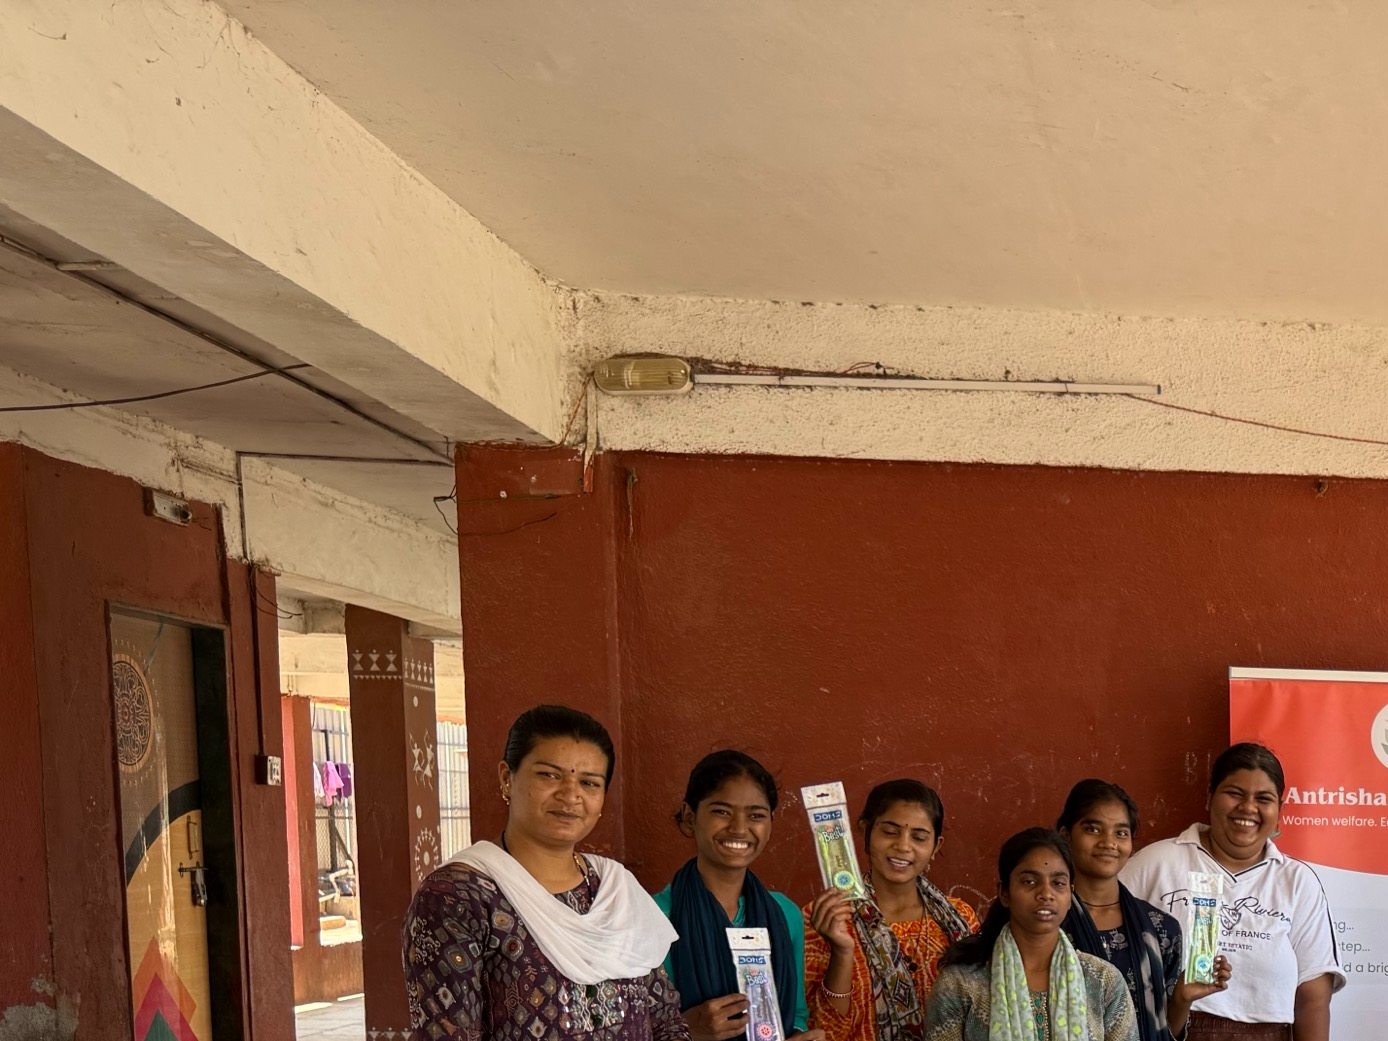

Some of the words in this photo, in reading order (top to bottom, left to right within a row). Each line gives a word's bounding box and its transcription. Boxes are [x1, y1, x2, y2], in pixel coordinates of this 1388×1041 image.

[1284, 787, 1387, 806] Antrisha
[1282, 815, 1329, 826] Women
[1331, 817, 1377, 827] welfare.
[1235, 930, 1271, 940] FRANCE
[1338, 941, 1371, 954] tep...
[1355, 963, 1364, 973] a
